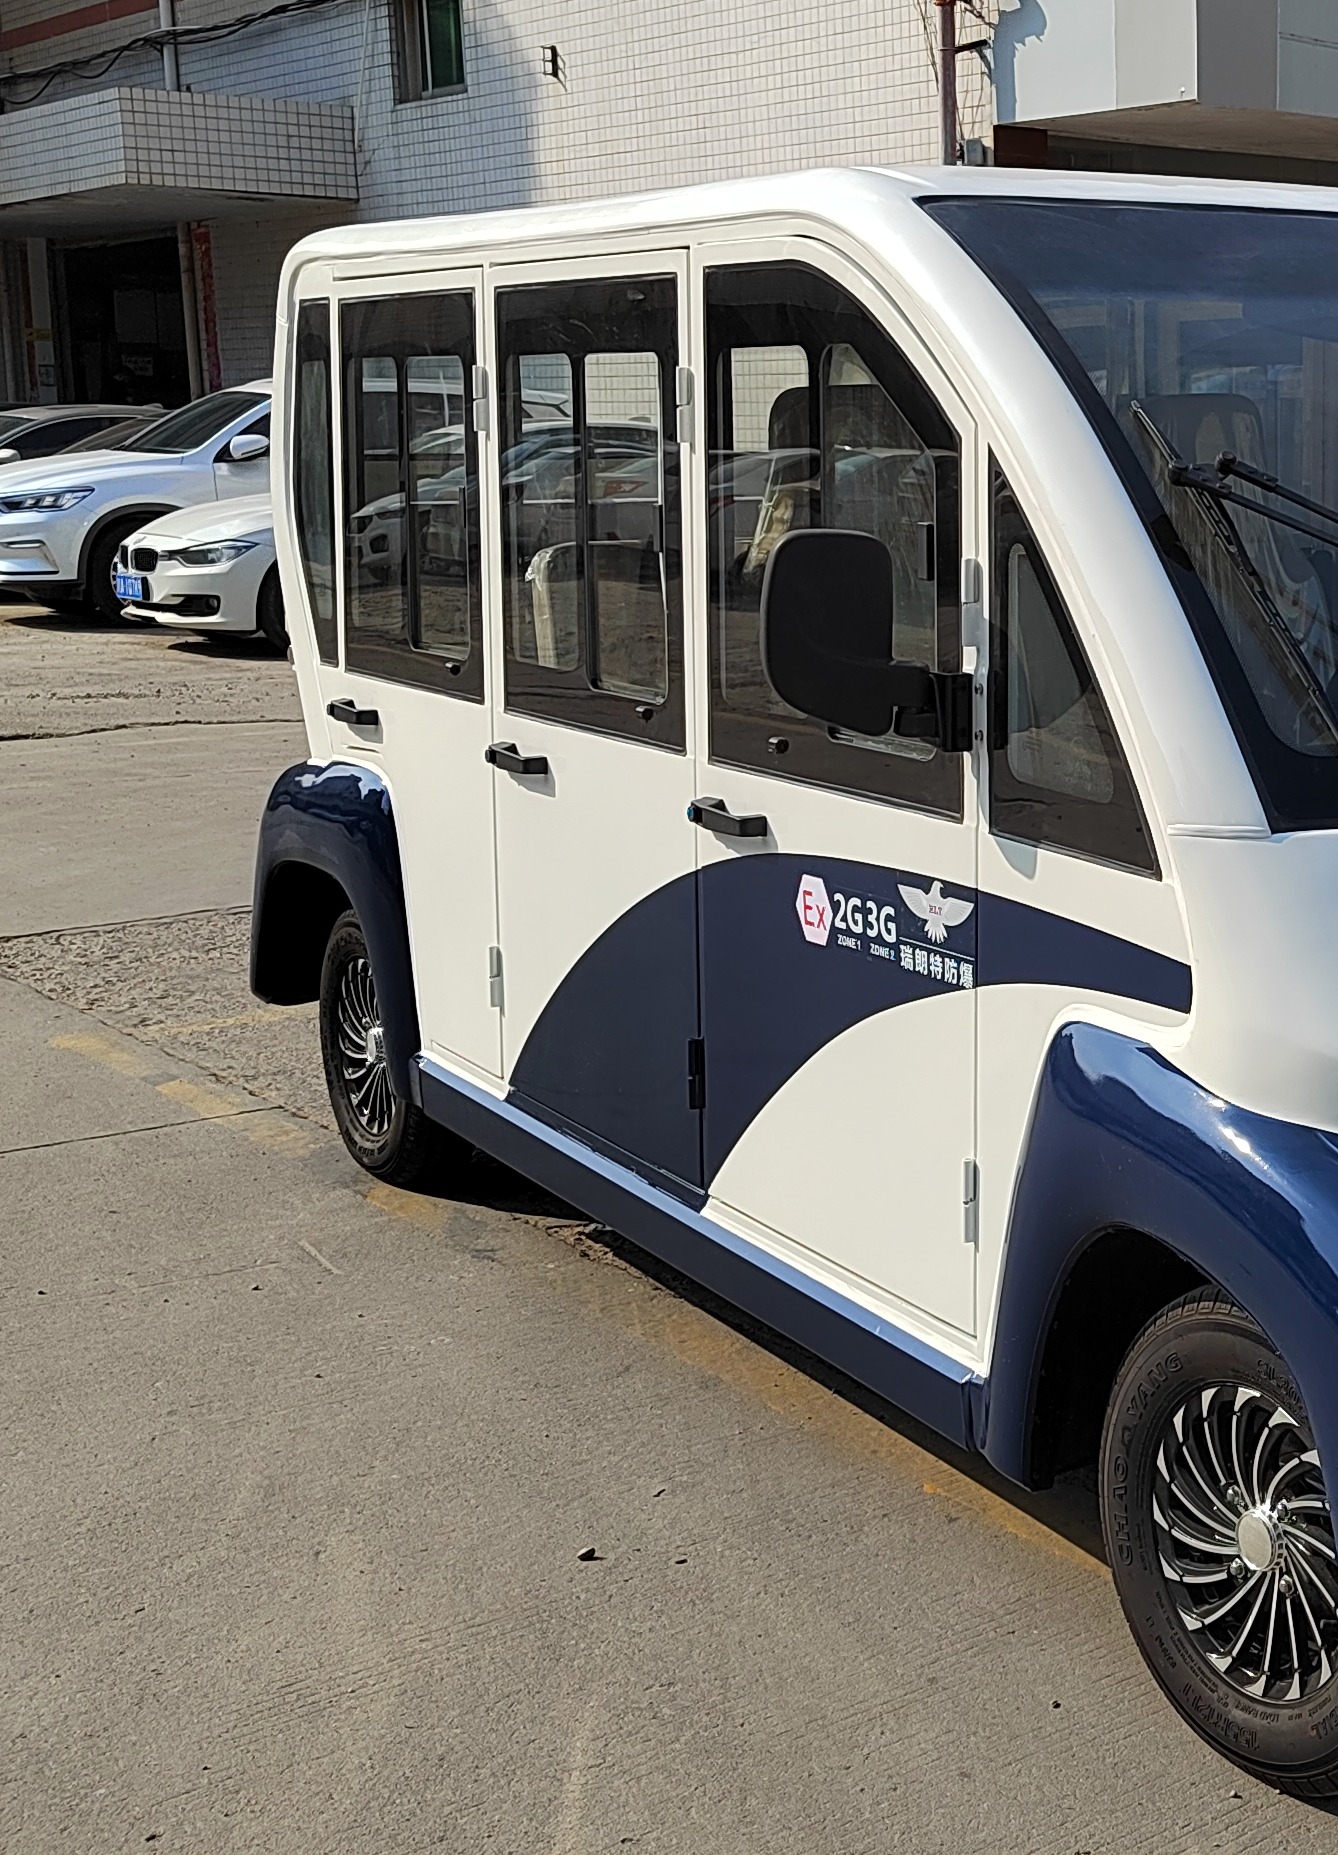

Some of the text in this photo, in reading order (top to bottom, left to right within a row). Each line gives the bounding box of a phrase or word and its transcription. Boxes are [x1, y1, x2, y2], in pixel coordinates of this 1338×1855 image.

[802, 889, 827, 932] Ex
[898, 944, 974, 989] 瑞朗特防爆
